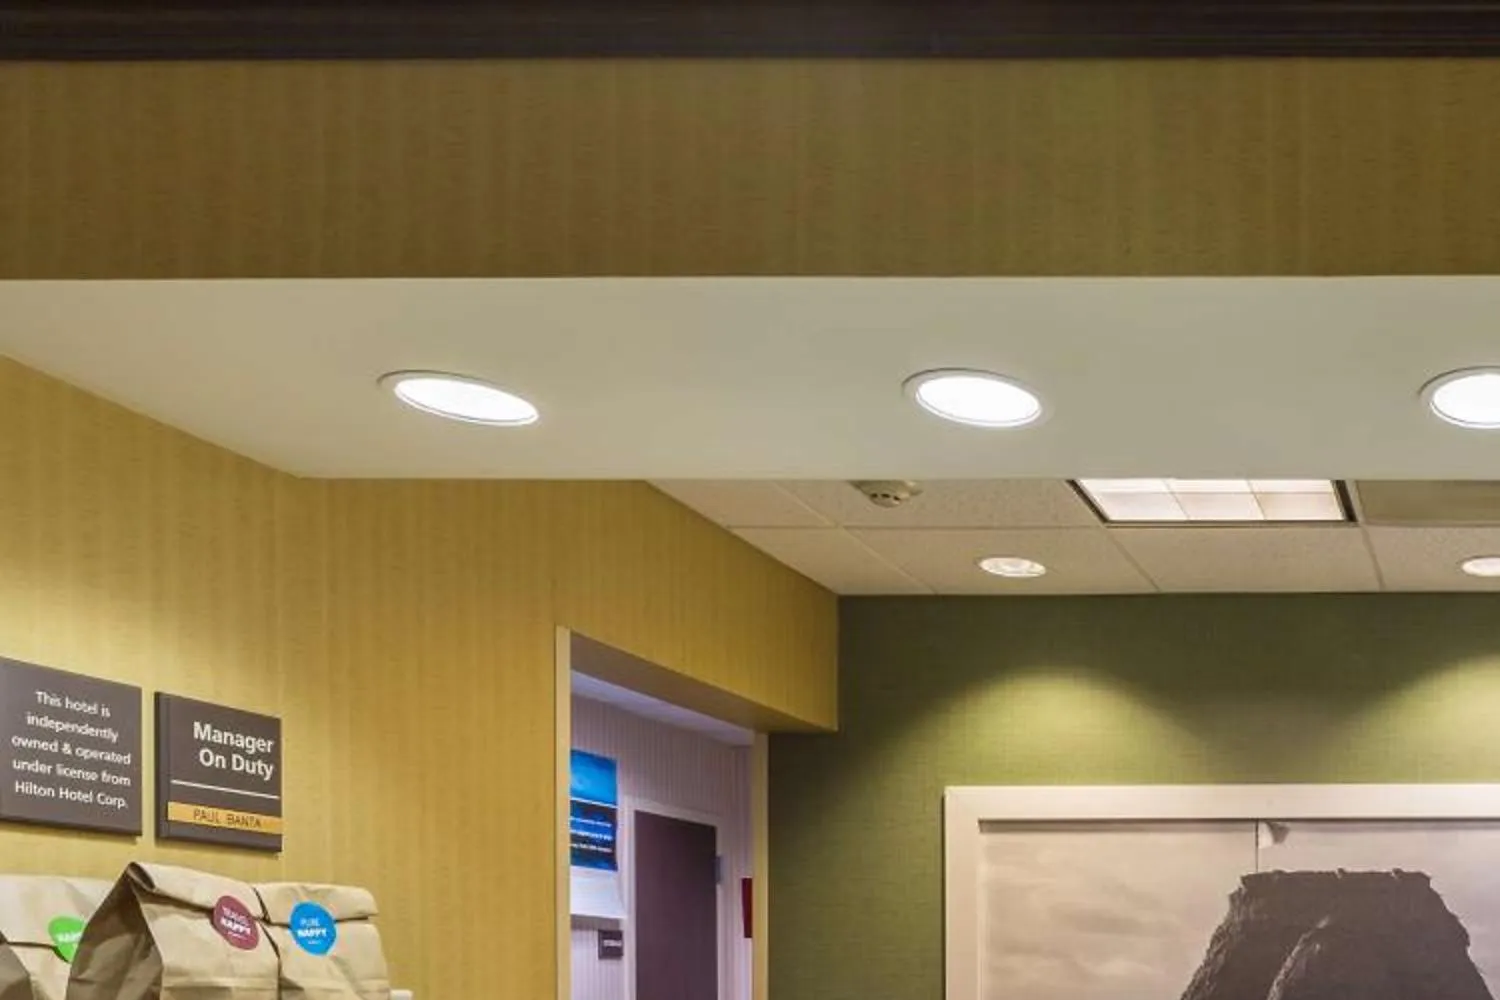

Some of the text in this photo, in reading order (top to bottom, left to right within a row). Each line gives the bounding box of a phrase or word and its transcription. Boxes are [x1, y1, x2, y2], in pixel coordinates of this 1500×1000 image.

[36, 690, 111, 718] This hotel is
[26, 711, 119, 743] independently
[193, 721, 275, 754] Manager
[11, 735, 131, 765] owned & operated
[199, 748, 274, 781] On Duty
[13, 759, 132, 787] under license from
[15, 780, 129, 809] Hilton Hotel Corp.
